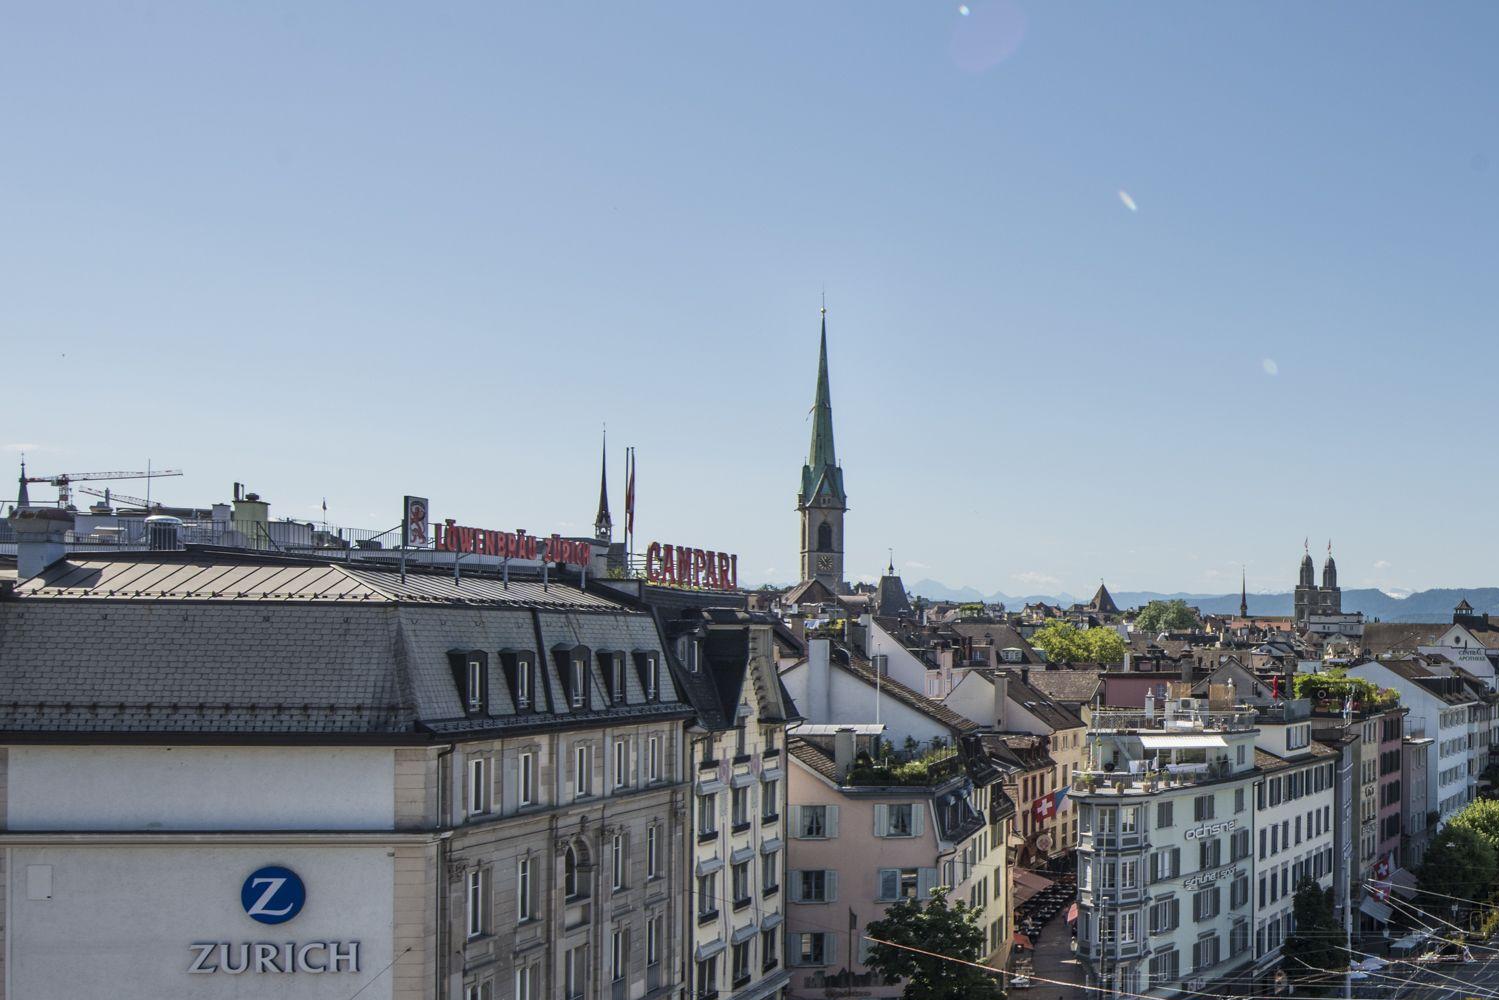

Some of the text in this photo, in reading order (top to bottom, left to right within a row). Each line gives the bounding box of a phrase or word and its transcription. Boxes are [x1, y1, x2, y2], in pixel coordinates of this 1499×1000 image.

[434, 518, 591, 566] LÖWENBRÄU ZÜRICH
[646, 541, 738, 591] CAMPARI
[187, 940, 361, 976] ZURICH
